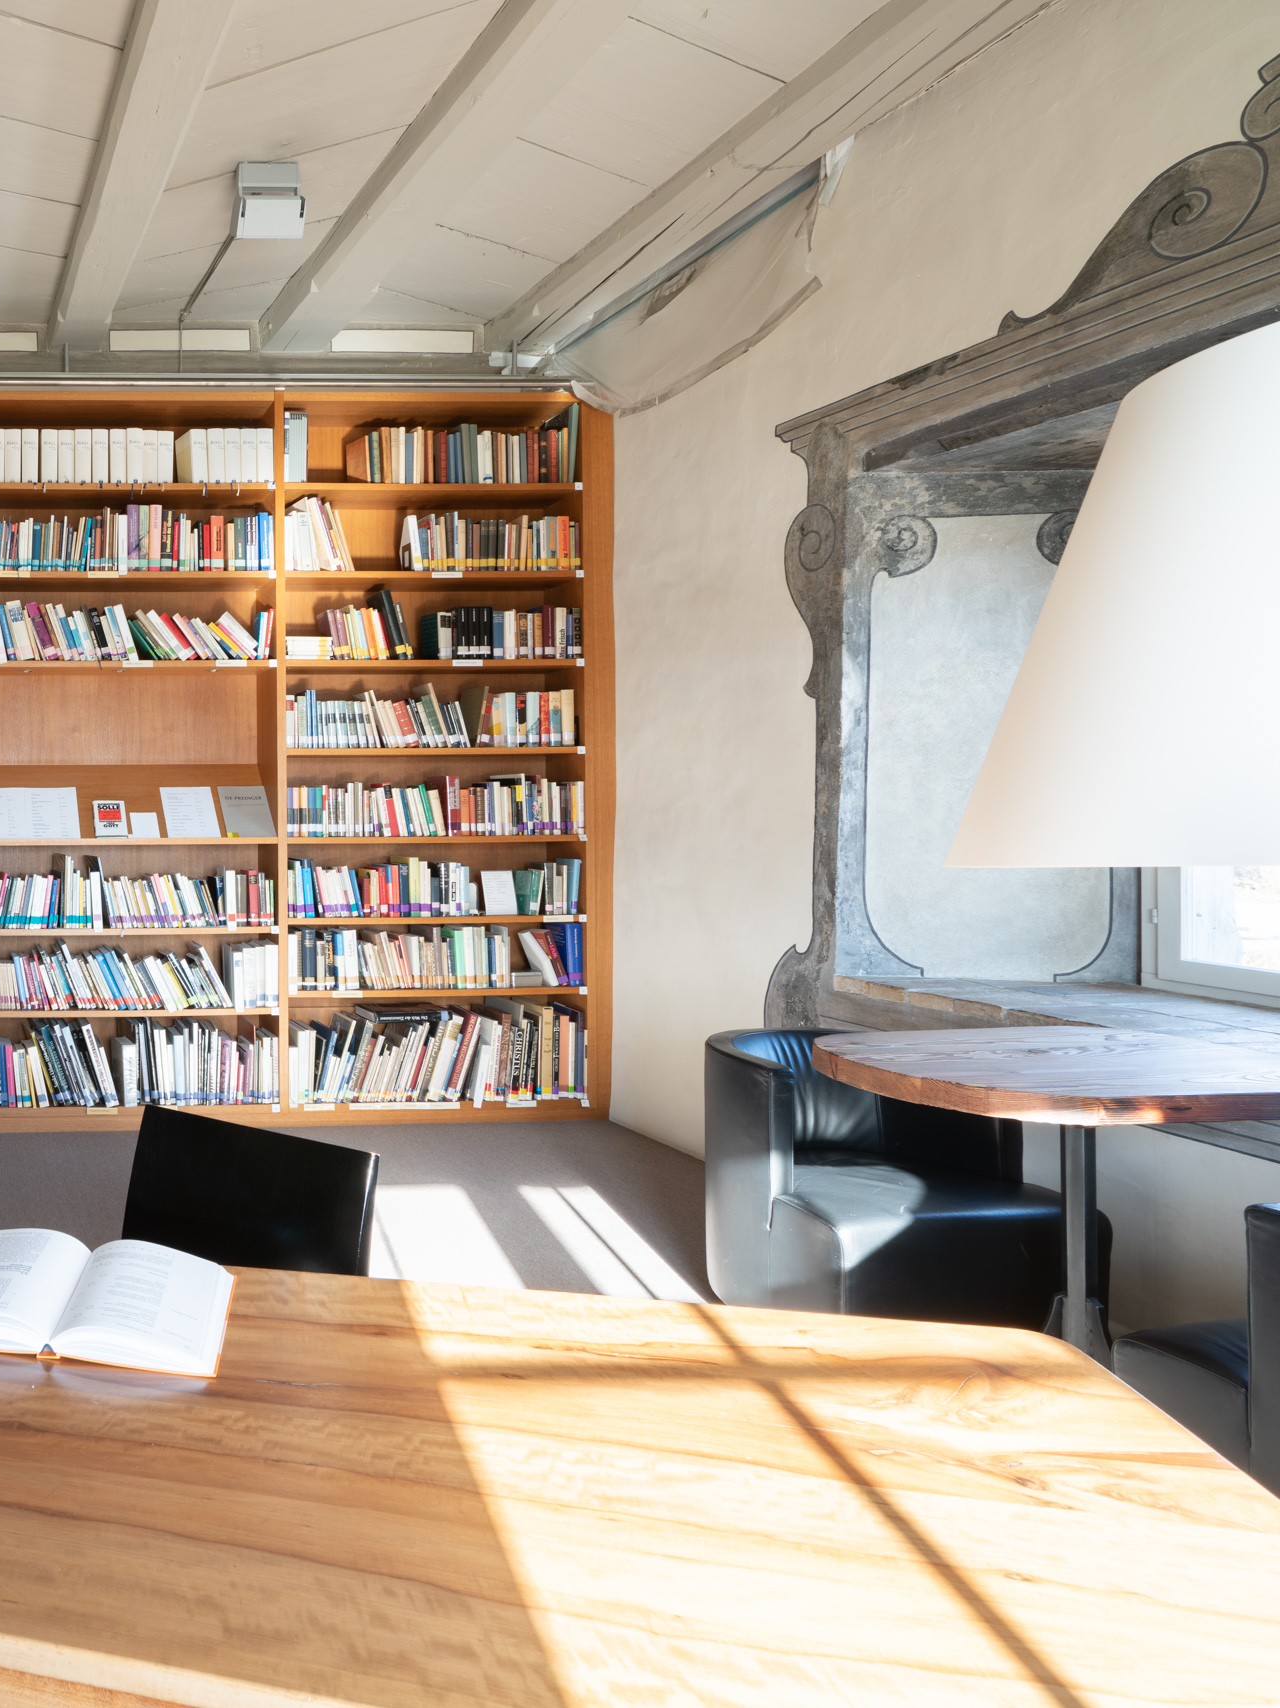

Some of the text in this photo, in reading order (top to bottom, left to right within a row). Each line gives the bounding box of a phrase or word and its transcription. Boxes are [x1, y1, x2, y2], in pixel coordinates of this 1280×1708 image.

[426, 1026, 445, 1079] MARC CHAGALL
[455, 1047, 467, 1072] RELIGIONEN
[513, 1032, 523, 1075] CHRISTUS
